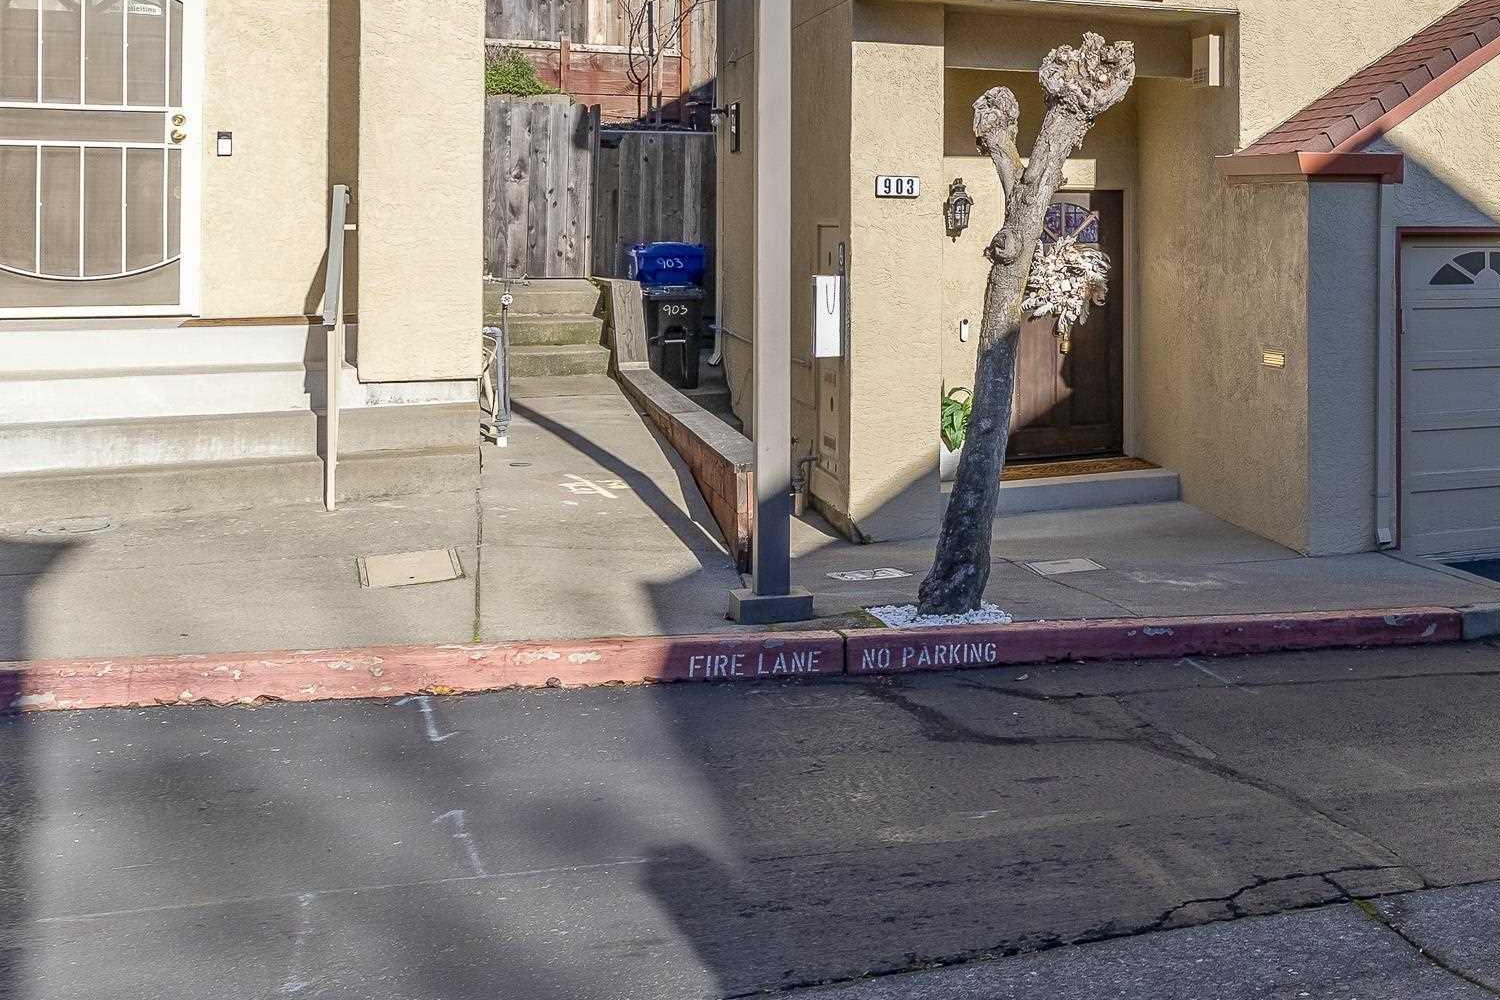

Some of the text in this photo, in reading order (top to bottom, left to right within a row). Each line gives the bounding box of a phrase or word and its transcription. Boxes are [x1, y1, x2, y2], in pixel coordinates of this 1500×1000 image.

[884, 179, 914, 194] 903
[656, 257, 684, 269] 903
[663, 304, 688, 316] 903
[862, 642, 997, 669] NO PARKING
[689, 651, 822, 677] FIRE LANE
